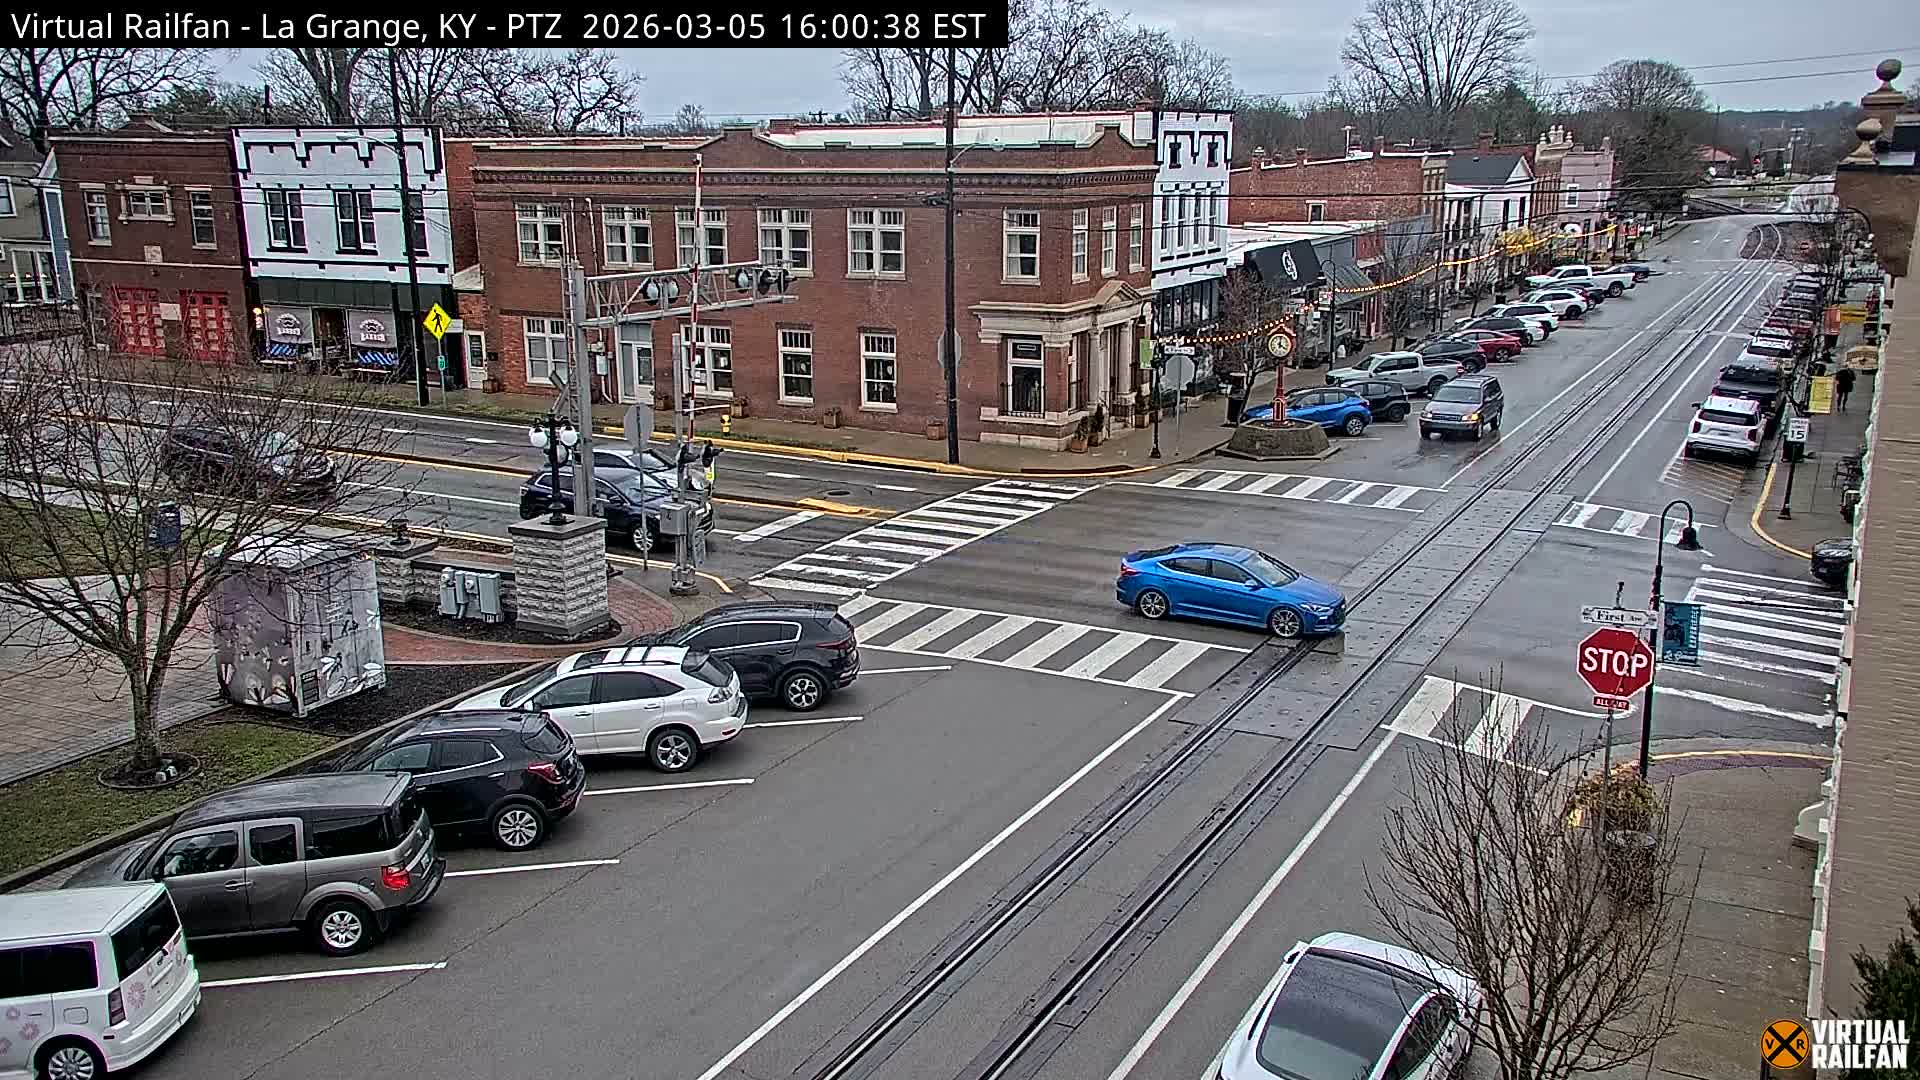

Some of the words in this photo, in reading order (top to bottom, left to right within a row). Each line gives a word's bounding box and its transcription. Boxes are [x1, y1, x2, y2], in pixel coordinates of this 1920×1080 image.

[1791, 430, 1805, 440] 15
[1597, 610, 1625, 622] First
[1582, 646, 1649, 678] STOP
[1596, 698, 1609, 706] ALL
